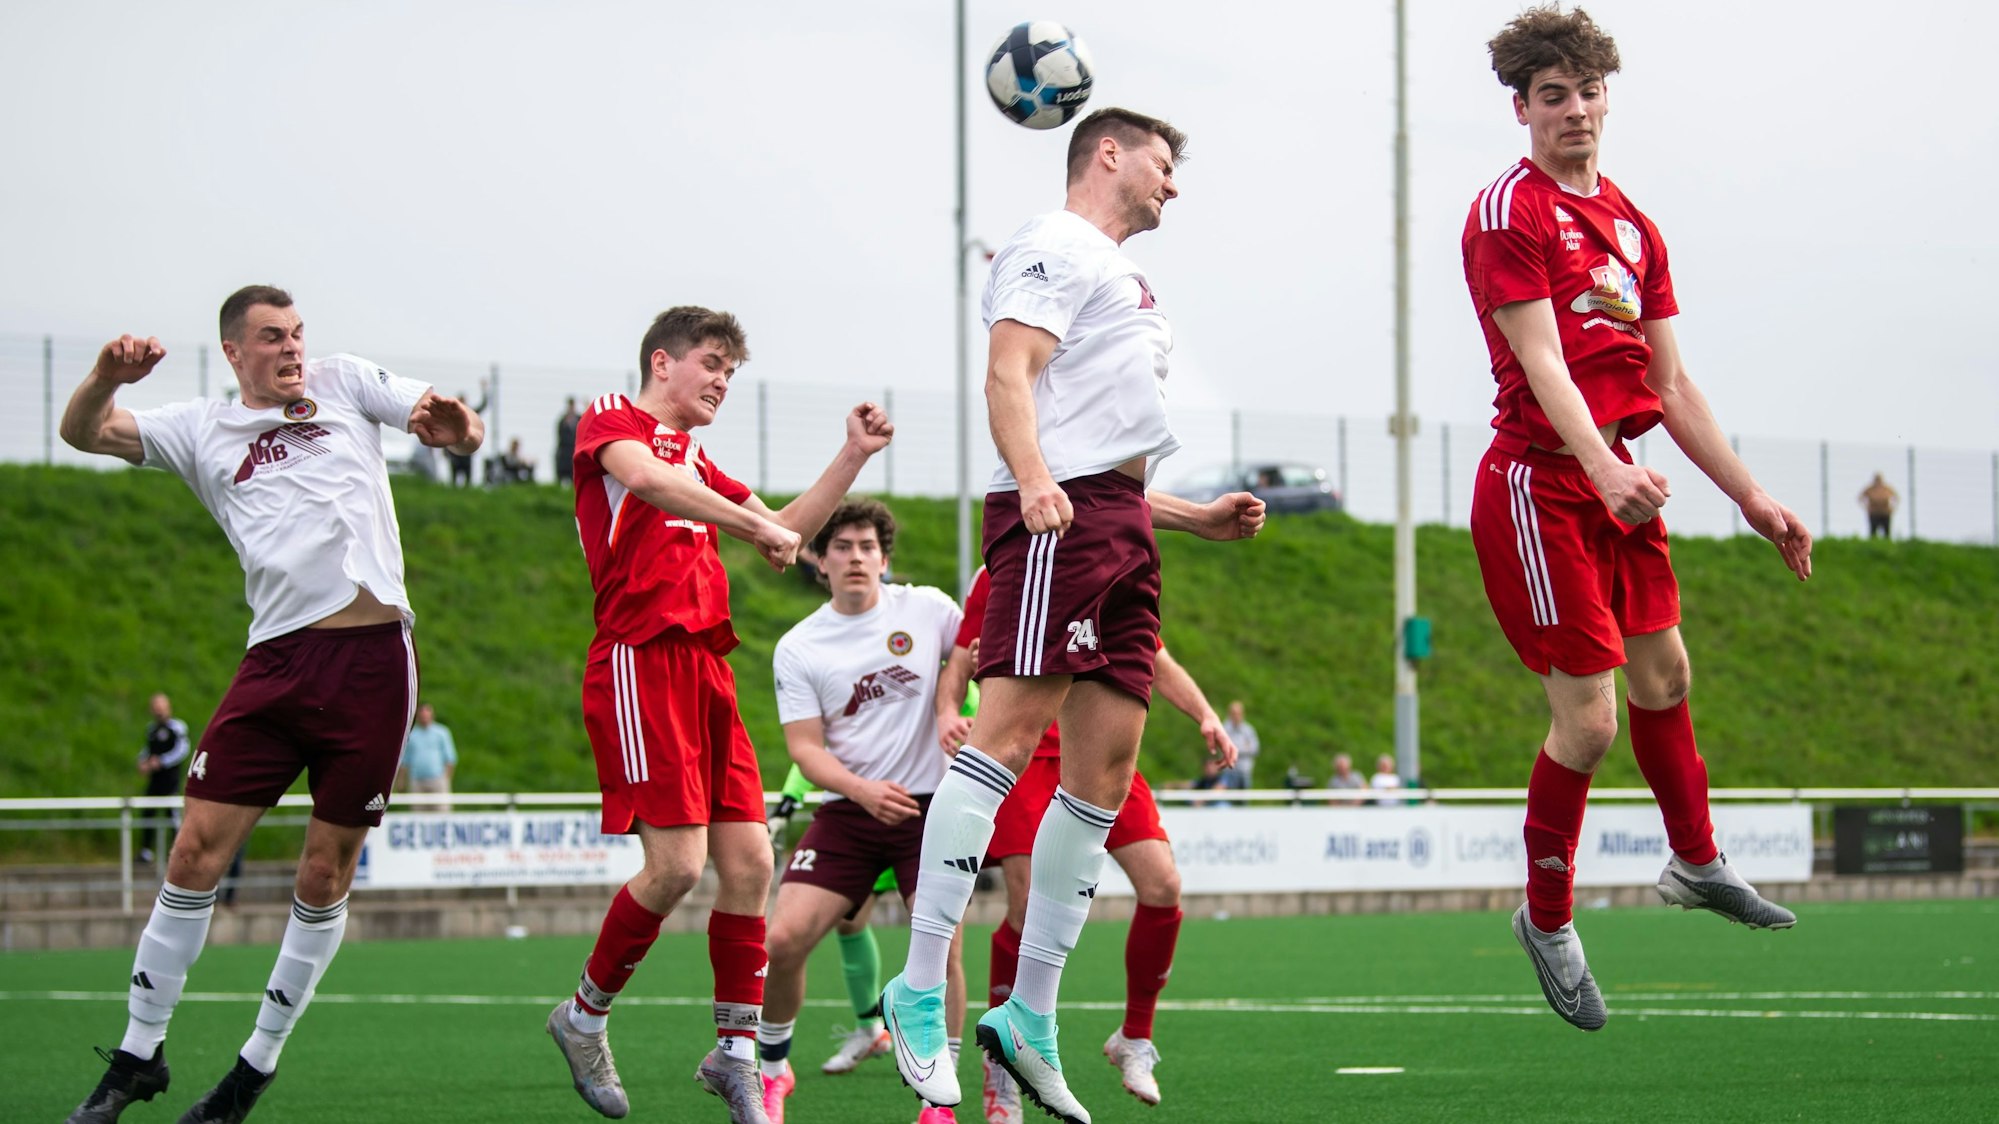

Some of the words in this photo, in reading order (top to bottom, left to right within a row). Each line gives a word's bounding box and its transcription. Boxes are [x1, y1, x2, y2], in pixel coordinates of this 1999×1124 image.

[1021, 271, 1049, 282] adidas
[1066, 618, 1099, 653] 24
[187, 749, 209, 781] 14
[1325, 832, 1400, 862] Allianz
[1599, 832, 1664, 857] Allianz
[790, 848, 818, 871] 22
